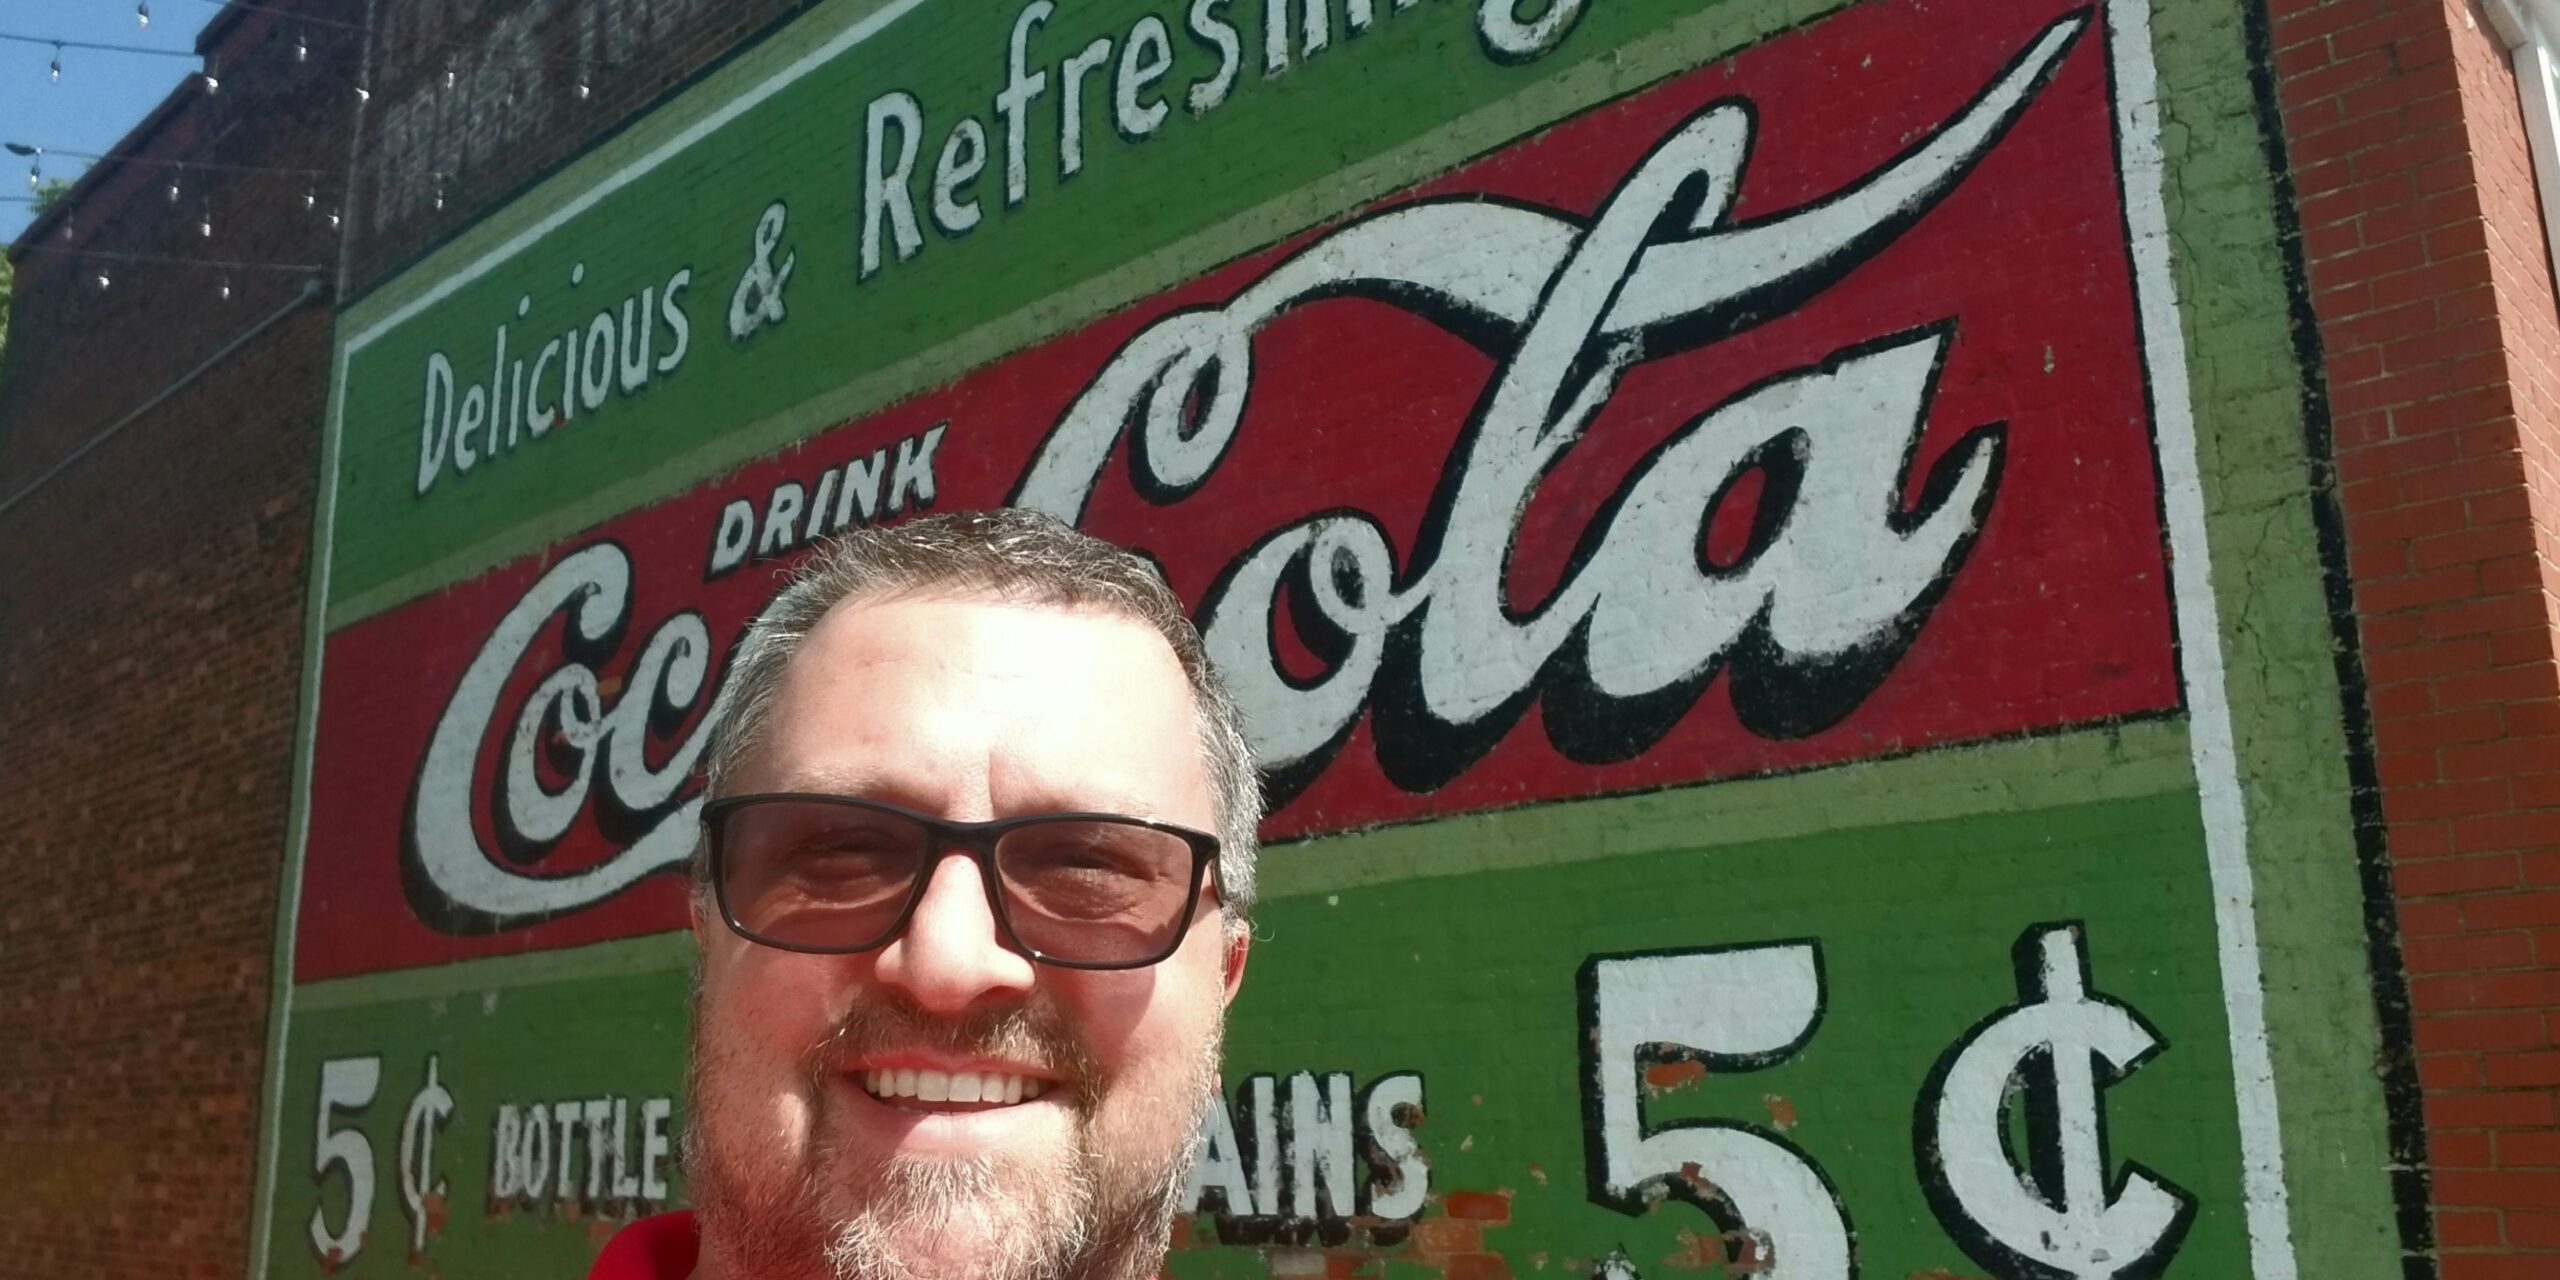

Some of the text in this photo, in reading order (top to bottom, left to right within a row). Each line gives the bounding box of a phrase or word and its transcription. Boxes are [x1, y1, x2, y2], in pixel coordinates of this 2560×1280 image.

[415, 262, 691, 497] Delicious
[729, 200, 796, 342] &
[705, 422, 949, 580] DRINK
[490, 1094, 672, 1206] BOTTLE
[1180, 1070, 1433, 1235] AINS
